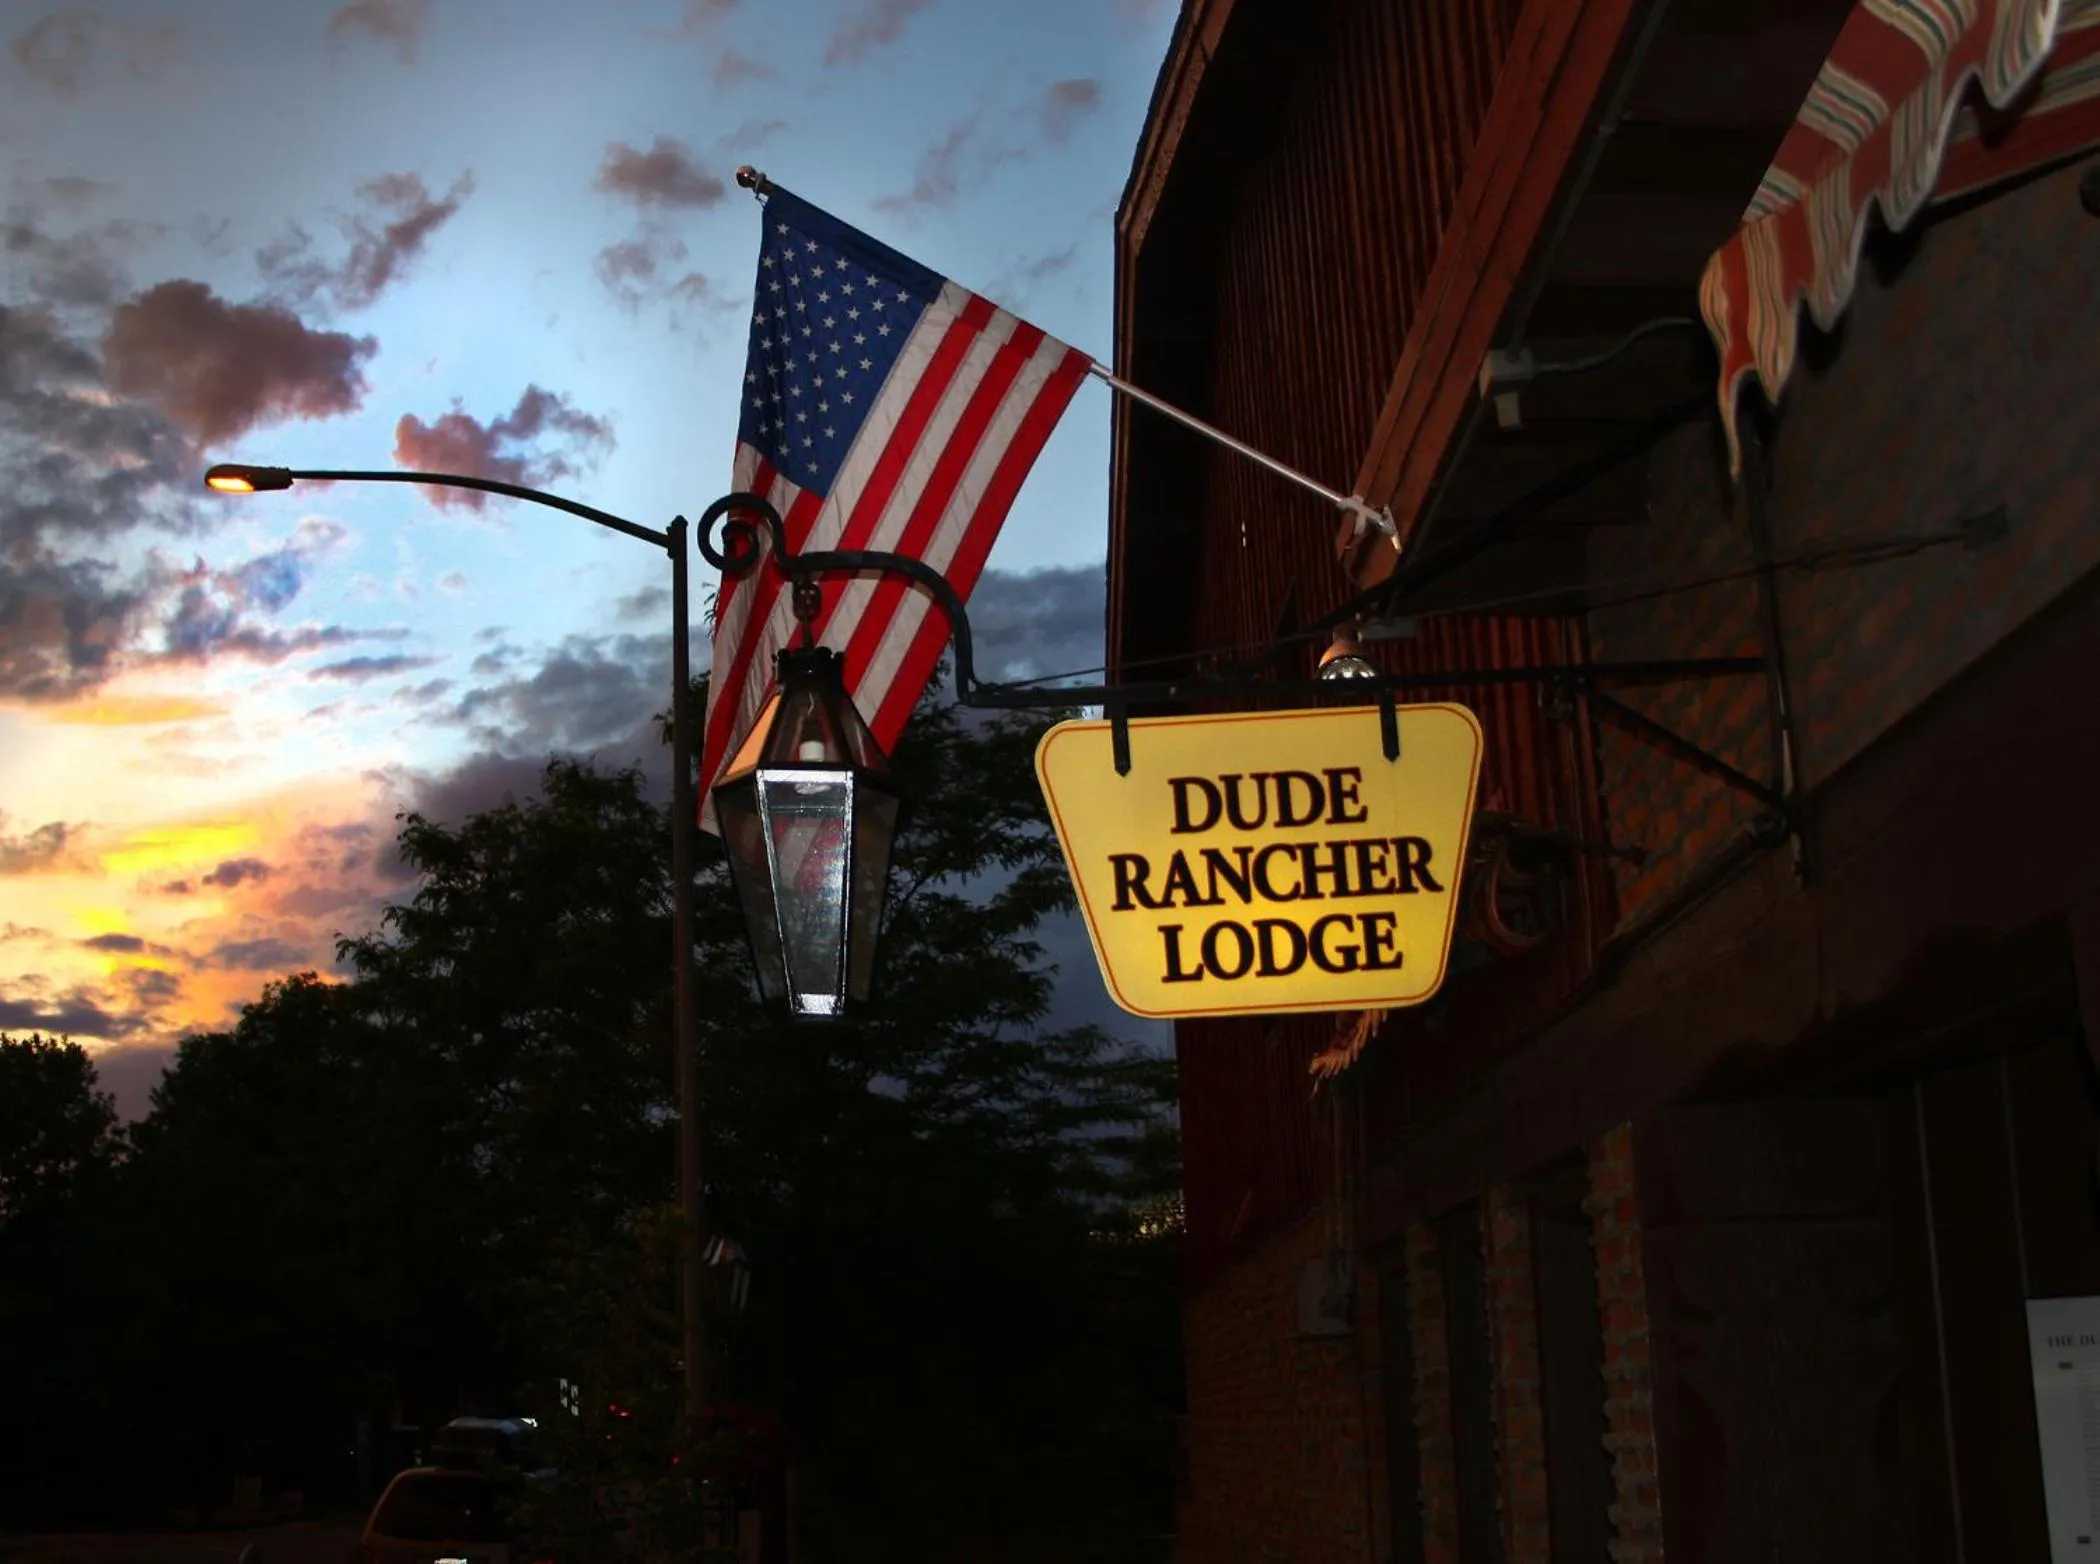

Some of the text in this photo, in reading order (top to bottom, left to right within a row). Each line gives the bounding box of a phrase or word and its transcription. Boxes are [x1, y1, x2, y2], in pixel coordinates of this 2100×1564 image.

[1167, 767, 1368, 834] DUDE
[1108, 836, 1444, 911] RANCHER
[1157, 912, 1404, 983] LODGE
